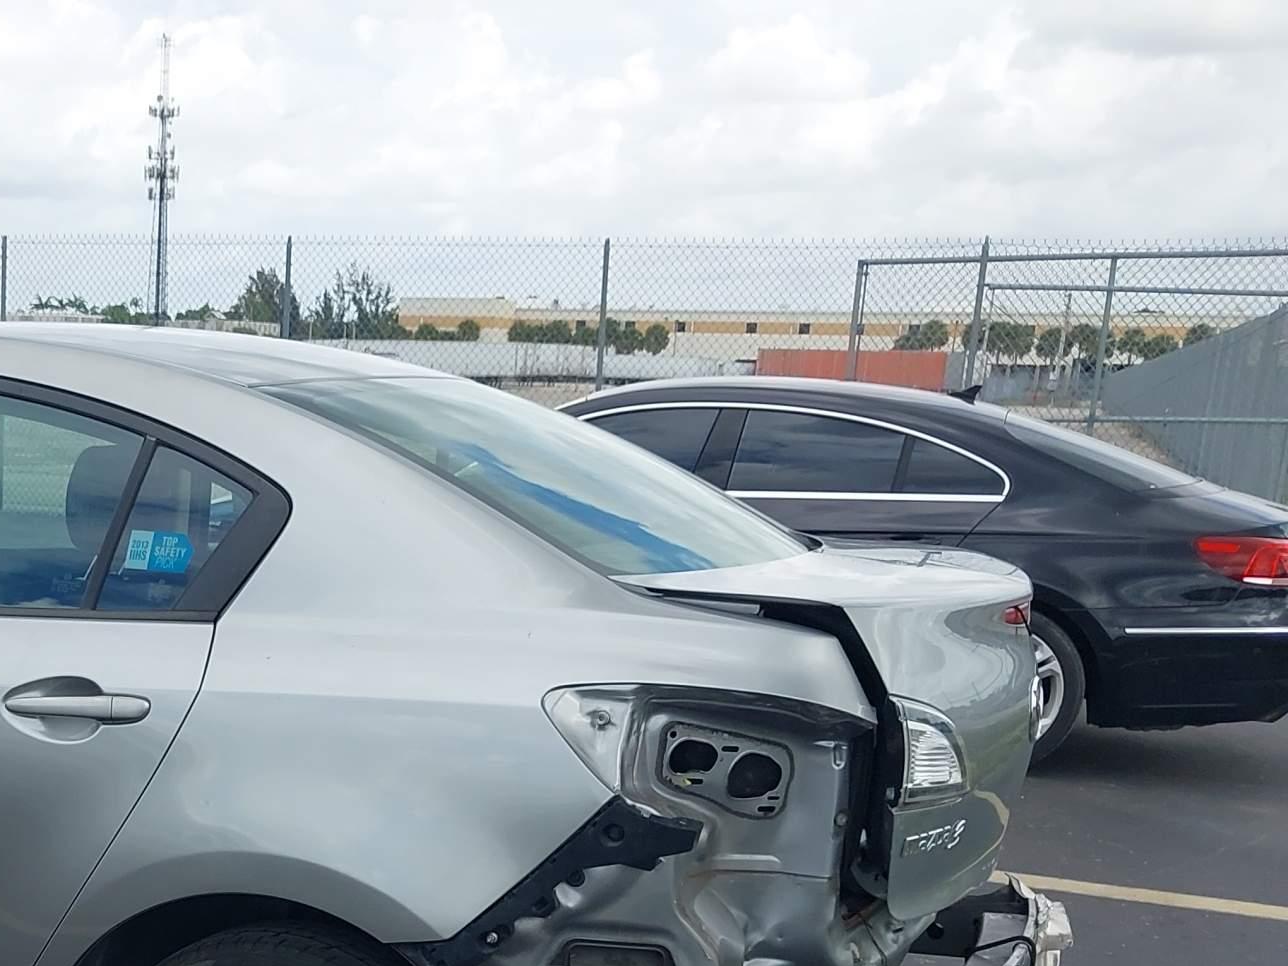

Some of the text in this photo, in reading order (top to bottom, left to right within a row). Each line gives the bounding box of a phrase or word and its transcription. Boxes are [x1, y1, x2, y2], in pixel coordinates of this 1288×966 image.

[131, 539, 150, 549] 2013
[162, 536, 179, 546] TOP
[128, 550, 148, 561] IIHS
[153, 547, 187, 557] SAFETY
[153, 557, 176, 569] PICK
